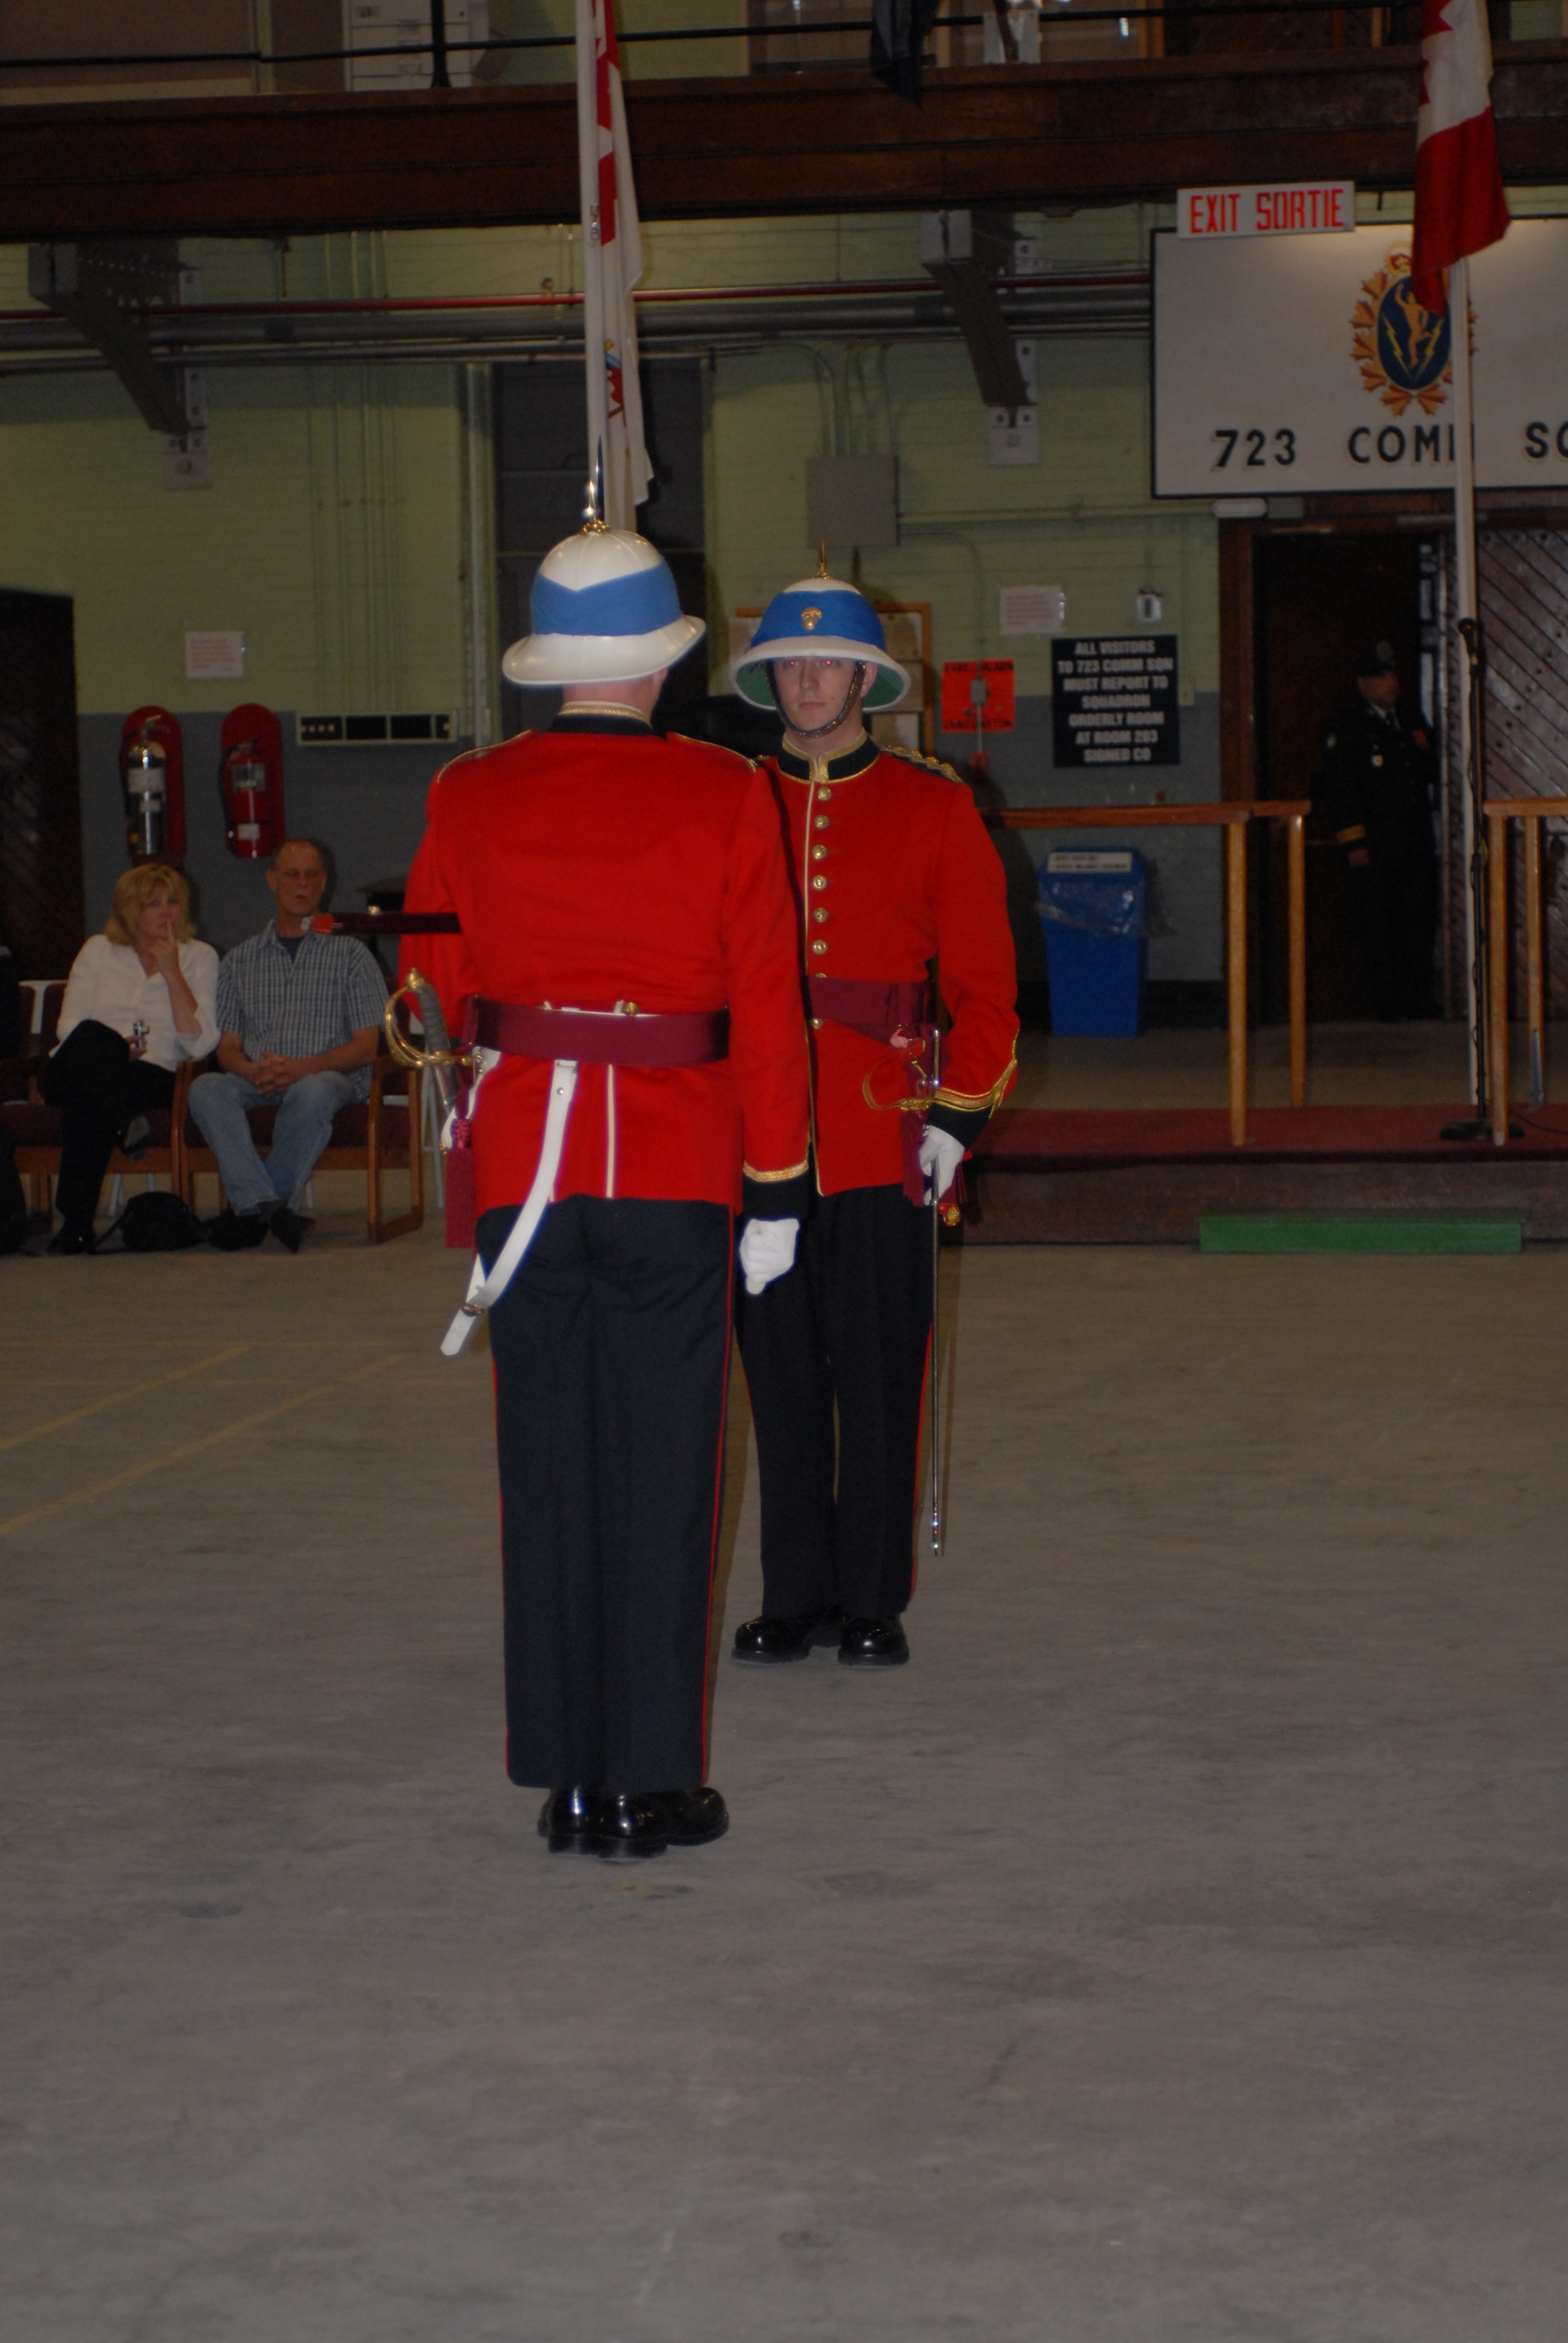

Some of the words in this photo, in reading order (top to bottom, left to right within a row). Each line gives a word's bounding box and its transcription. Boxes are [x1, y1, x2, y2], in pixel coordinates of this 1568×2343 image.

[1190, 193, 1240, 234] EXIT
[1256, 188, 1345, 231] SORTIE
[1214, 427, 1297, 467] 723
[1075, 641, 1097, 655] ALL
[1100, 640, 1155, 654] VISITORS
[1057, 660, 1073, 673] TO
[1077, 660, 1100, 673] 723
[1102, 658, 1143, 672] COMM
[1146, 657, 1173, 671] SQN
[1063, 678, 1099, 691] MUST
[1102, 676, 1149, 690] REPORT
[1152, 675, 1168, 689] TO
[1082, 694, 1151, 709] SQUADRON
[1069, 713, 1124, 727] ORDERLY
[1126, 711, 1164, 724] ROOM
[1076, 731, 1091, 744] AT
[1094, 730, 1131, 743] ROOM
[1084, 747, 1130, 762] SIGNED
[1133, 747, 1151, 761] CO
